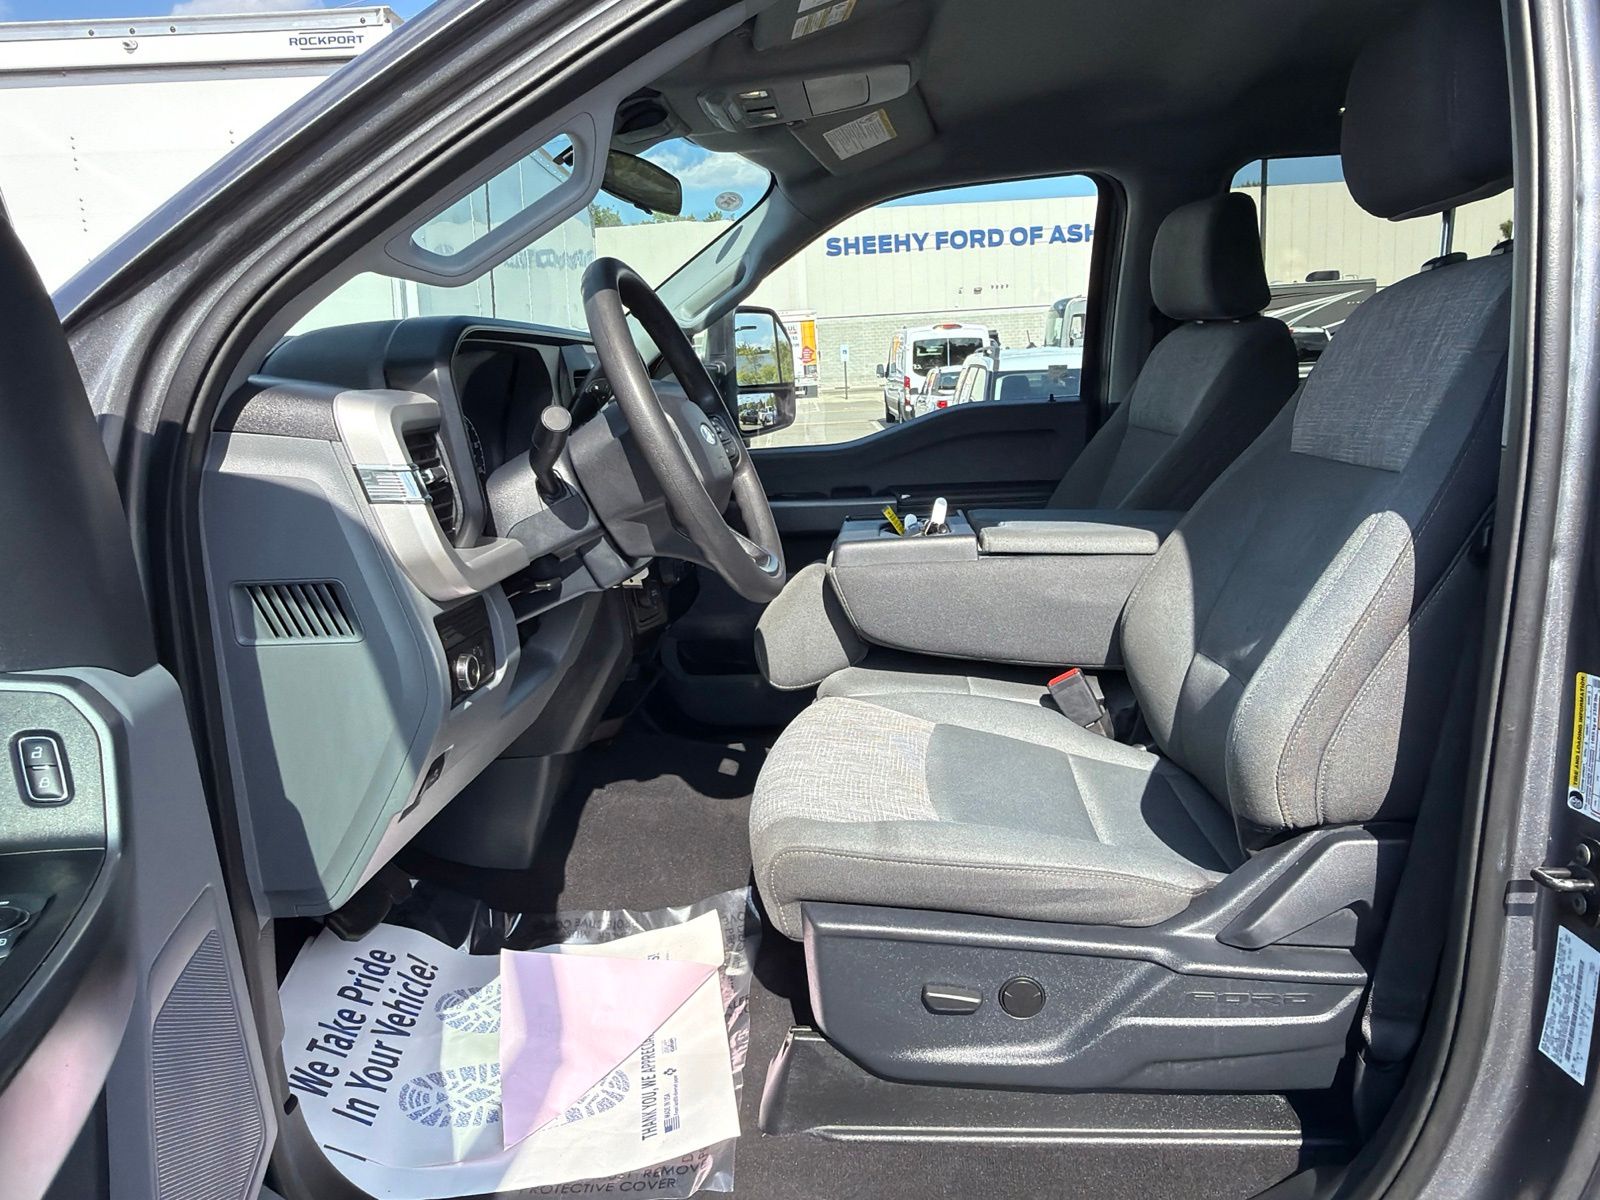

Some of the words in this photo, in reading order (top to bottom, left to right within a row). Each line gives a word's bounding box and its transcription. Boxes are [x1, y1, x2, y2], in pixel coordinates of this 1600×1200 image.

[289, 35, 364, 46] ROCKPORT
[825, 232, 930, 257] SHEEHY
[934, 228, 1005, 250] FORD
[1009, 225, 1044, 246] OF
[1575, 724, 1583, 754] LOADING
[336, 949, 397, 1007] Pride
[370, 952, 439, 1037] Vehicle!
[1187, 991, 1314, 1007] FORD
[306, 1008, 367, 1059] Take
[288, 1061, 340, 1098] We
[344, 1039, 403, 1093] Your
[641, 1074, 657, 1090] WE
[331, 1097, 380, 1127] In
[641, 1087, 660, 1111] YOU,
[641, 1108, 658, 1141] THANK
[619, 1178, 676, 1193] COVER
